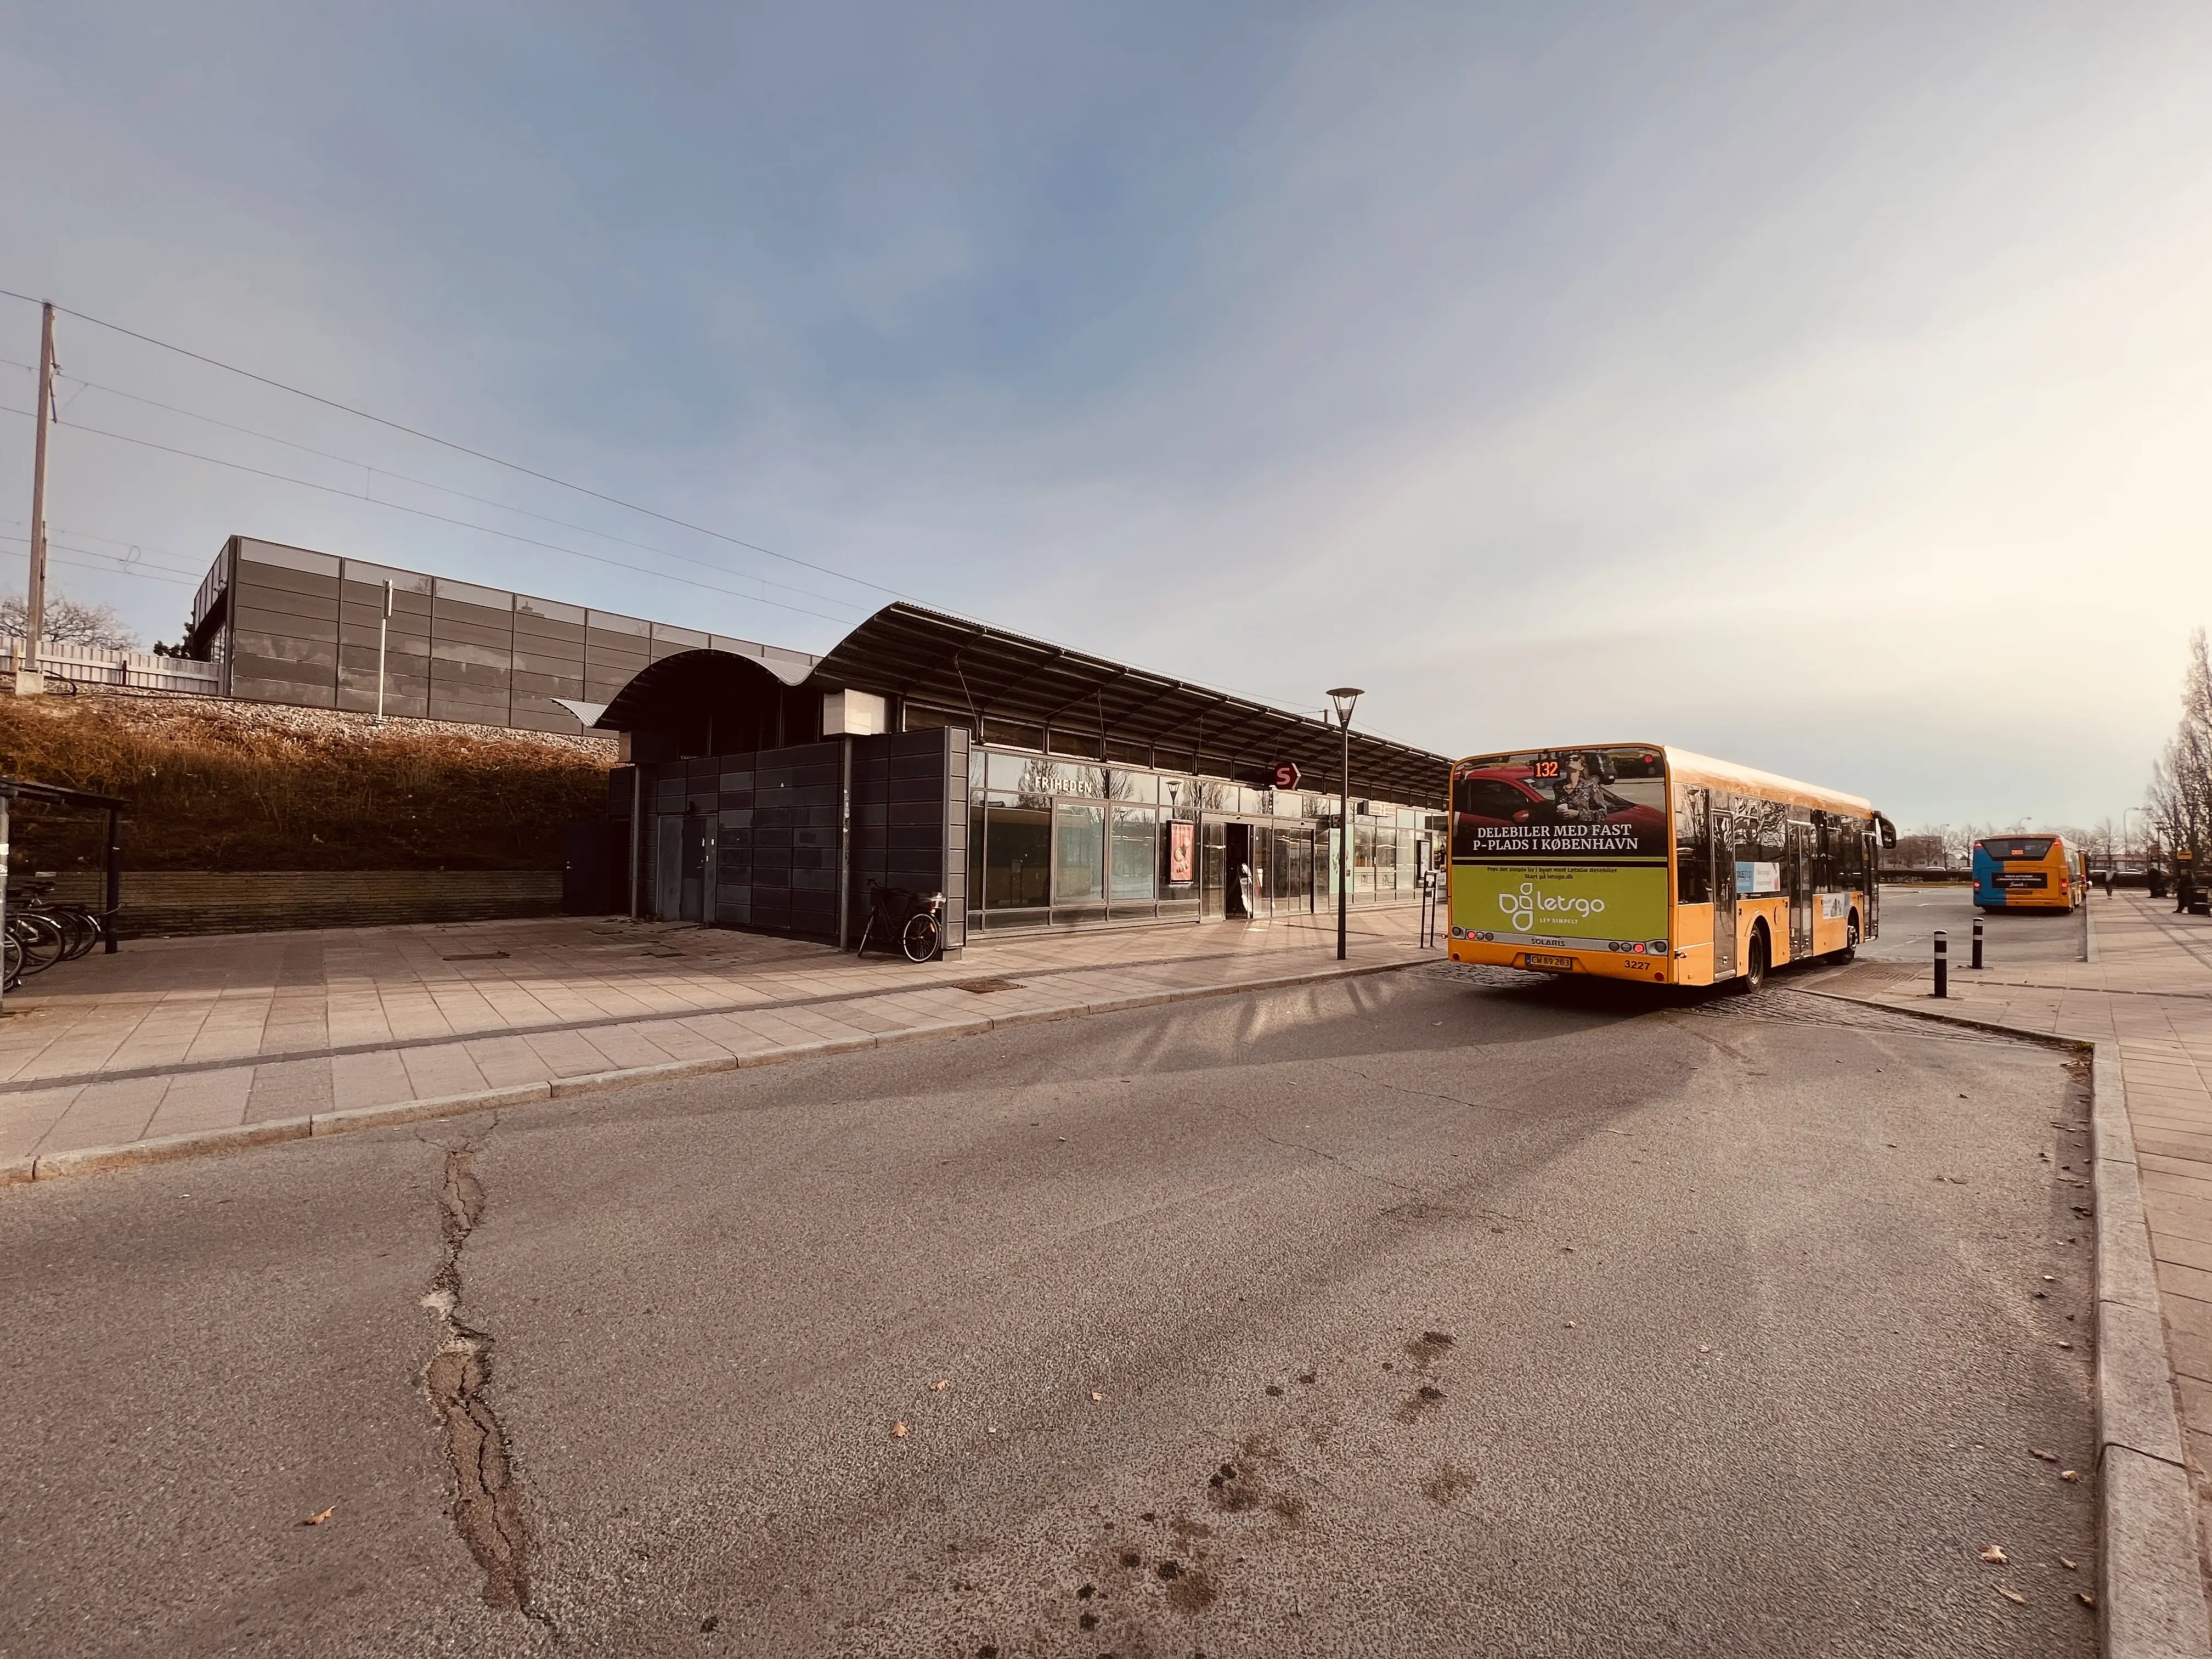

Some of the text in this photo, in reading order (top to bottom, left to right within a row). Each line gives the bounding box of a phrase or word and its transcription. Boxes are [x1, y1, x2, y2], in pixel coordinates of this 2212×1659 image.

[1277, 768, 1290, 785] S
[1536, 761, 1558, 777] 132
[1035, 776, 1092, 793] FRIHEDEN
[1477, 824, 1632, 838] DELEBILER MED FAST
[1473, 838, 1638, 851] P-PLADS I KØBENHAVN
[1537, 891, 1605, 918] letsgo
[1531, 938, 1565, 947] SOLARIS
[1624, 960, 1651, 970] 3227
